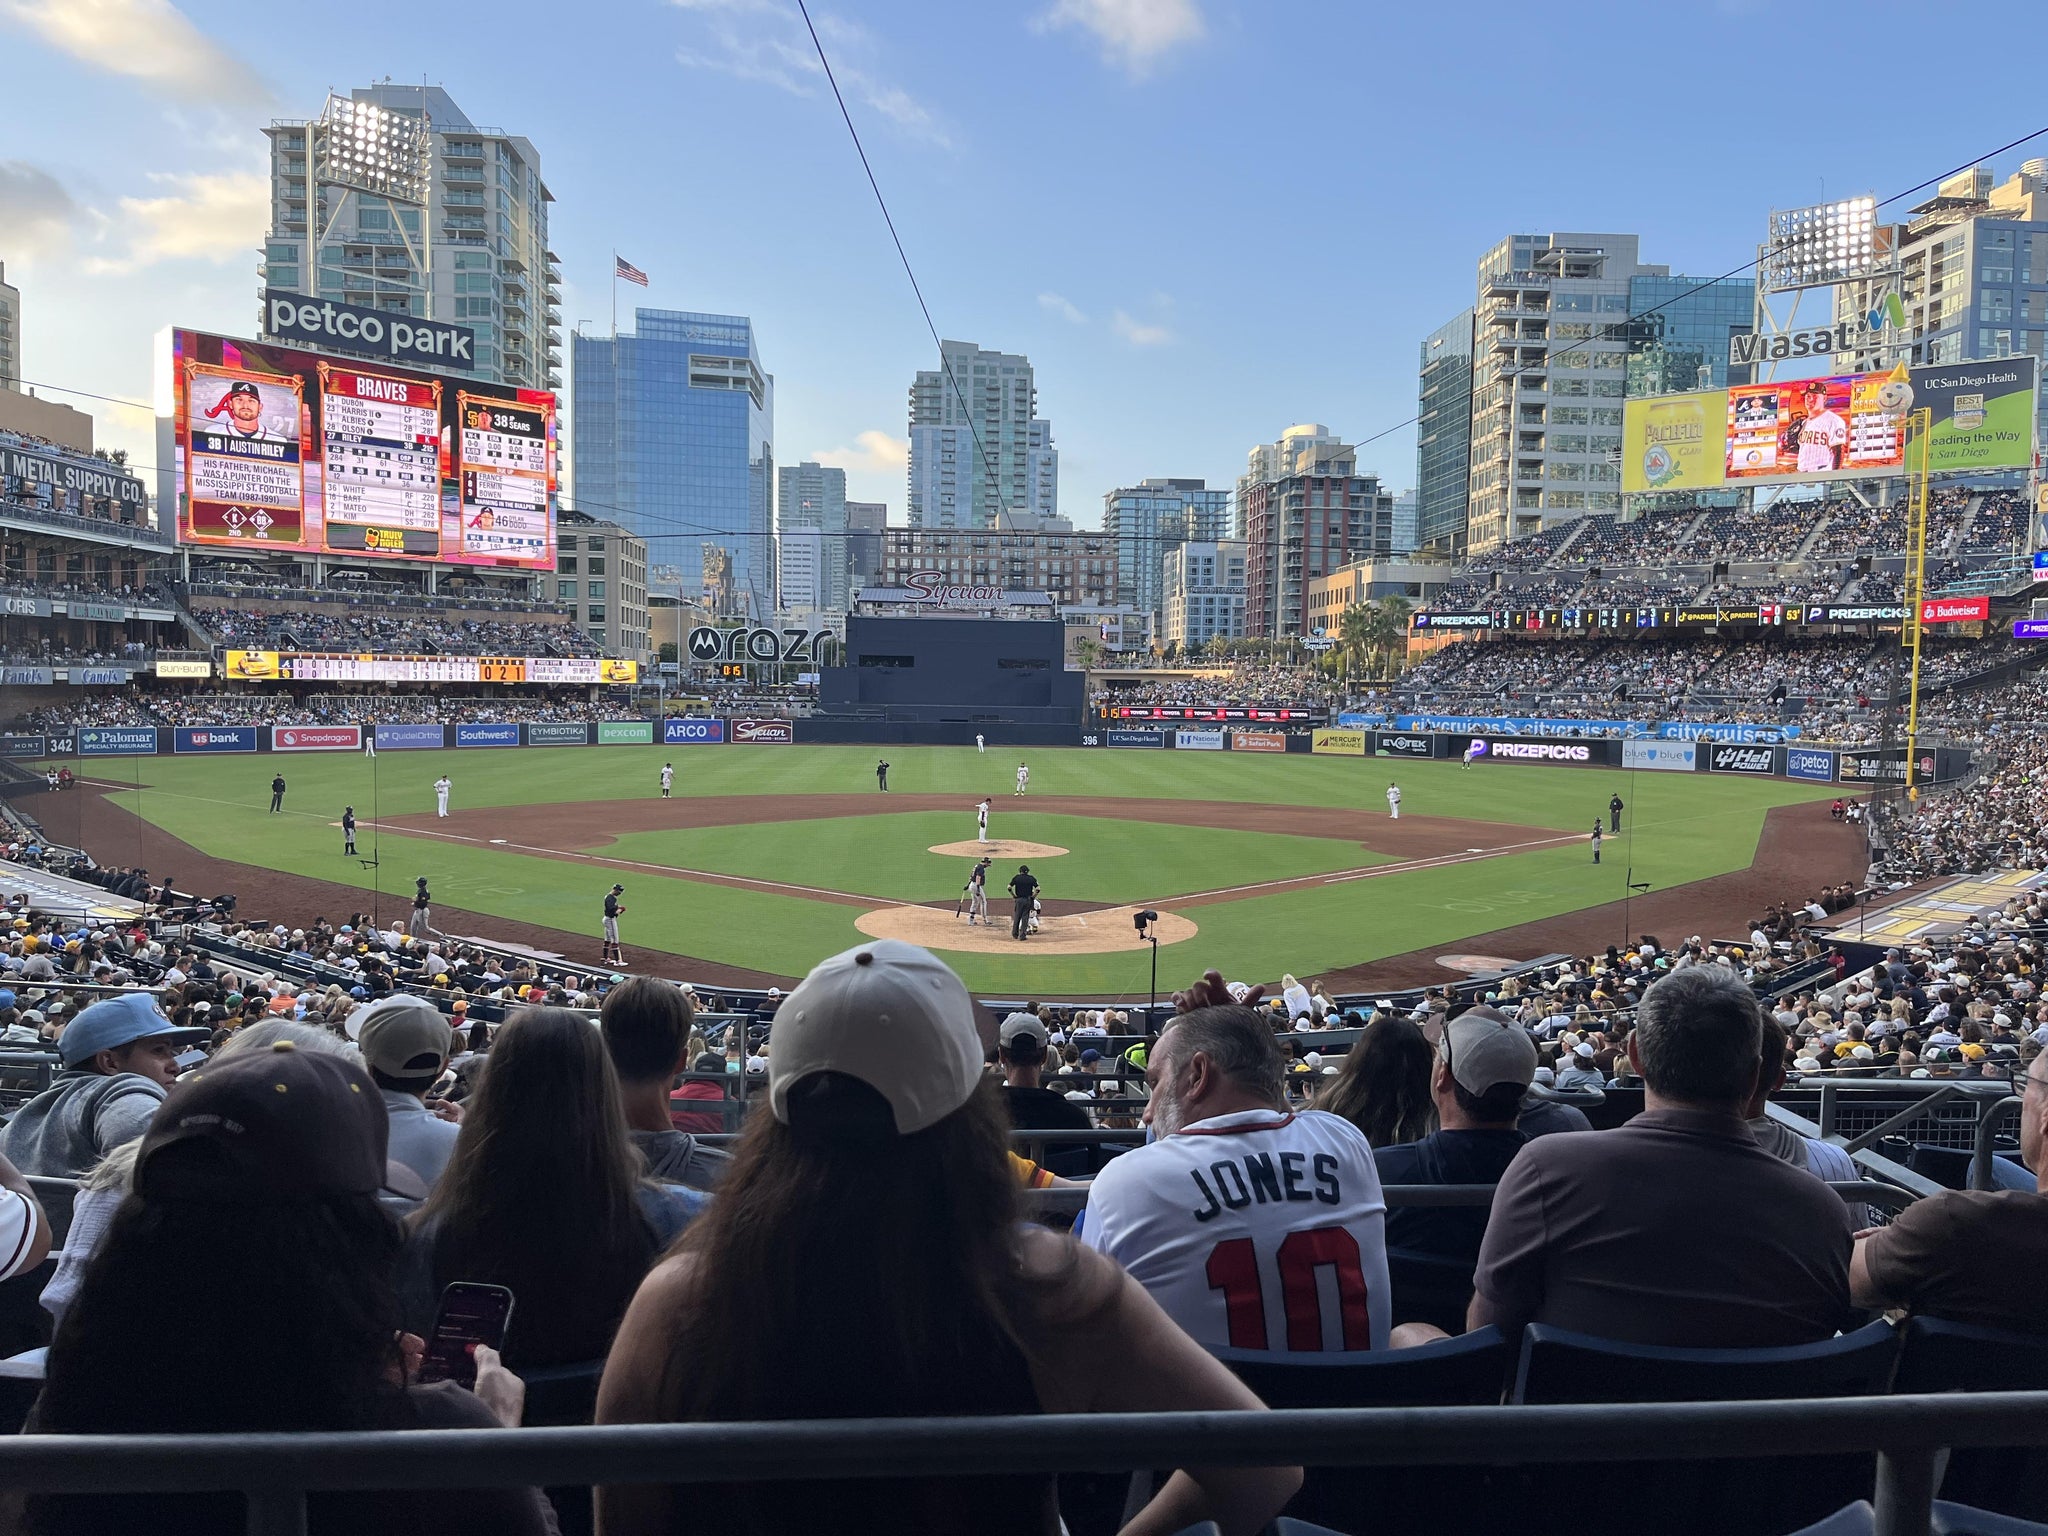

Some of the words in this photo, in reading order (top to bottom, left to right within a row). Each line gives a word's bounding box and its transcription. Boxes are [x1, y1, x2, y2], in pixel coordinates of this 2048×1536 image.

[271, 299, 384, 343] petco
[390, 322, 472, 360] park
[1735, 322, 1852, 363] Viasat
[1925, 379, 1939, 389] UC
[1940, 378, 1958, 388] San
[1959, 376, 1986, 387] Diego
[1987, 372, 2017, 383] Health
[356, 377, 407, 402] BRAVES
[1854, 400, 1877, 410] SEAR
[1956, 395, 1981, 406] BEST
[326, 404, 335, 412] 23
[341, 406, 367, 417] HARRIS
[404, 416, 412, 424] CF
[341, 415, 366, 425] ALBIES
[494, 414, 508, 427] 38
[341, 425, 365, 434] OLSON
[509, 421, 530, 431] SEARS
[327, 432, 335, 440] 27
[342, 434, 362, 443] RILEY
[404, 442, 413, 450] 3B
[1929, 434, 1970, 446] eading
[1974, 433, 1993, 442] the
[1996, 431, 2020, 442] Way
[208, 437, 222, 450] 3B
[229, 440, 261, 455] AUSTIN
[261, 443, 285, 457] RILEY
[1937, 450, 1957, 459] San
[1961, 448, 1989, 458] Diego
[203, 459, 217, 469] HIS
[219, 461, 251, 473] FATHER,
[253, 465, 290, 477] MICHAEL,
[13, 454, 62, 486] METAL
[65, 467, 117, 498] SUPPLY
[121, 481, 142, 504] CO.
[202, 469, 221, 478] WAS
[230, 472, 261, 483] PUNTER
[263, 476, 274, 484] ON
[275, 477, 291, 486] THE
[195, 478, 245, 490] MISSISSIPPI
[246, 483, 258, 492] ST.
[259, 484, 298, 496] FOOTBALL
[328, 484, 337, 492] 36
[343, 485, 366, 495] WHITE
[479, 482, 503, 490] FERMIN
[214, 490, 237, 499] TEAM
[239, 491, 280, 504] (1987-1991)
[479, 490, 502, 498] BOWEN
[343, 503, 367, 512] MATEO
[343, 512, 357, 520] KIM
[495, 515, 508, 527] 46
[903, 570, 1005, 608] Sycuan
[1829, 607, 1912, 619] PRIZEPICKS
[1936, 604, 1981, 617] Budweiser
[1430, 615, 1490, 626] PRIZEPICKS
[726, 627, 834, 663] razr
[82, 668, 118, 684] Canel's
[500, 666, 506, 680] 2
[723, 664, 741, 677] 0:15
[101, 733, 152, 742] Palomar
[391, 732, 440, 741] QuidelOrtho
[460, 730, 508, 740] Southwest
[531, 728, 585, 736] CYMBIOTIKA
[667, 725, 707, 737] ARCO
[736, 722, 786, 741] Sycuan
[193, 735, 207, 744] us
[209, 732, 239, 744] bank
[300, 733, 350, 744] Snapdragon
[1082, 735, 1098, 745] 396
[1383, 737, 1427, 748] EVOTEK
[51, 739, 72, 752] 342
[1492, 742, 1590, 760] PRIZEPICKS
[1625, 749, 1646, 758] blue
[1660, 751, 1682, 759] blue
[1737, 749, 1772, 763] H2O
[1732, 762, 1769, 770] POWER
[1801, 756, 1829, 769] petco
[1189, 1151, 1340, 1223] JONES
[1205, 1225, 1371, 1352] 10
